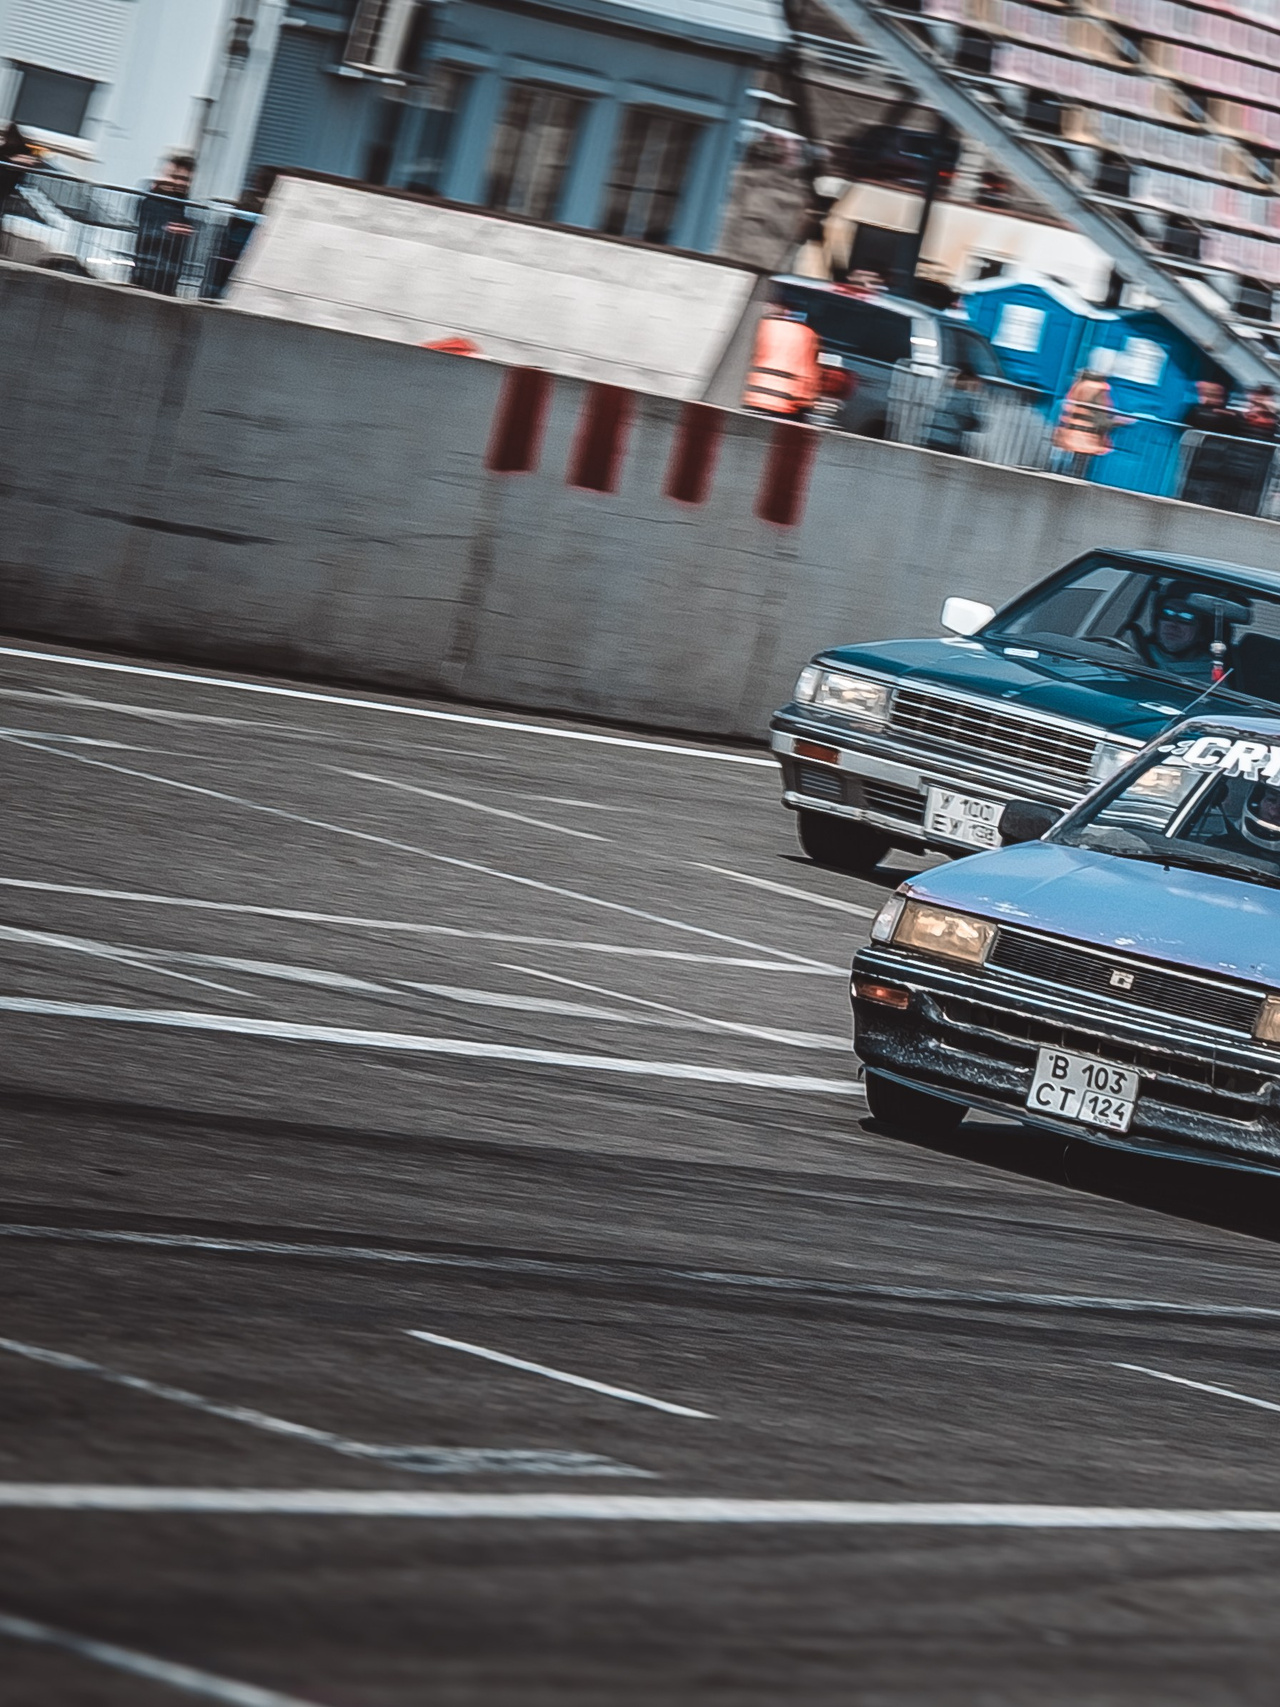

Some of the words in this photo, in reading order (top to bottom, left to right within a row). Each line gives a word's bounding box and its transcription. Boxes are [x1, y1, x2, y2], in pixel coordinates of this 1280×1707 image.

[960, 799, 995, 821] 100
[1081, 1064, 1128, 1094] 103
[1088, 1096, 1126, 1122] 124
